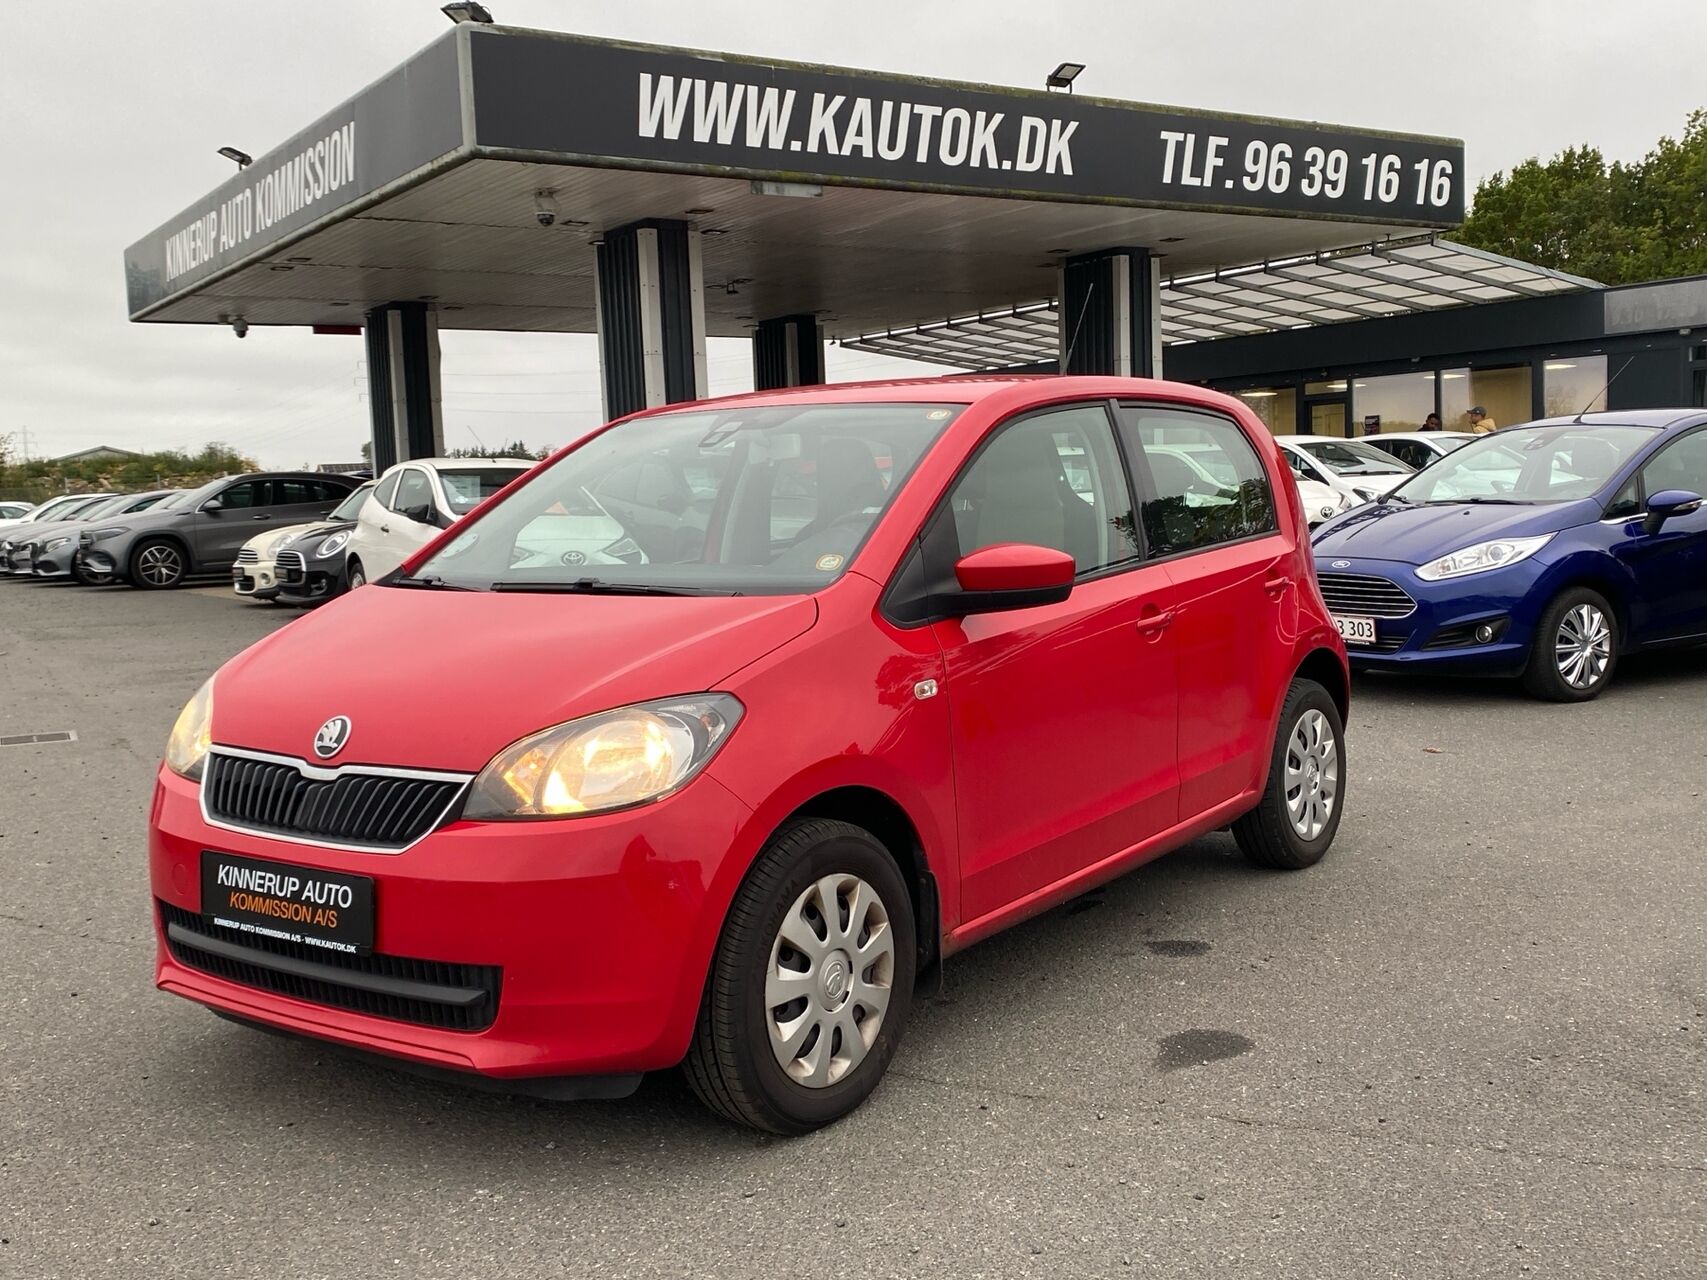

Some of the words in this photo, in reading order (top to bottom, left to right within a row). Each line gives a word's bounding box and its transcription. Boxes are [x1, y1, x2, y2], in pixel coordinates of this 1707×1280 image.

[638, 72, 1080, 176] WWW.KAUTOK.DK
[1160, 130, 1234, 189] TLF.
[1242, 140, 1293, 194] 96
[1300, 146, 1349, 199] 39
[1361, 153, 1402, 203] 16
[1414, 158, 1453, 207] 16
[165, 210, 218, 282] KINNERUP
[219, 188, 252, 253] AUTO
[255, 120, 355, 233] KOMMISSION
[1348, 620, 1373, 638] 303
[217, 864, 300, 898] KINNERUP
[301, 880, 353, 909] AUTO
[229, 891, 312, 924] KOMMISSION
[313, 908, 338, 928] A/S
[214, 917, 240, 930] KINNERUP
[240, 923, 255, 933] AUTO
[255, 926, 291, 941] KOMMISSION
[305, 936, 357, 954] WWW.KAUTOK.DK
